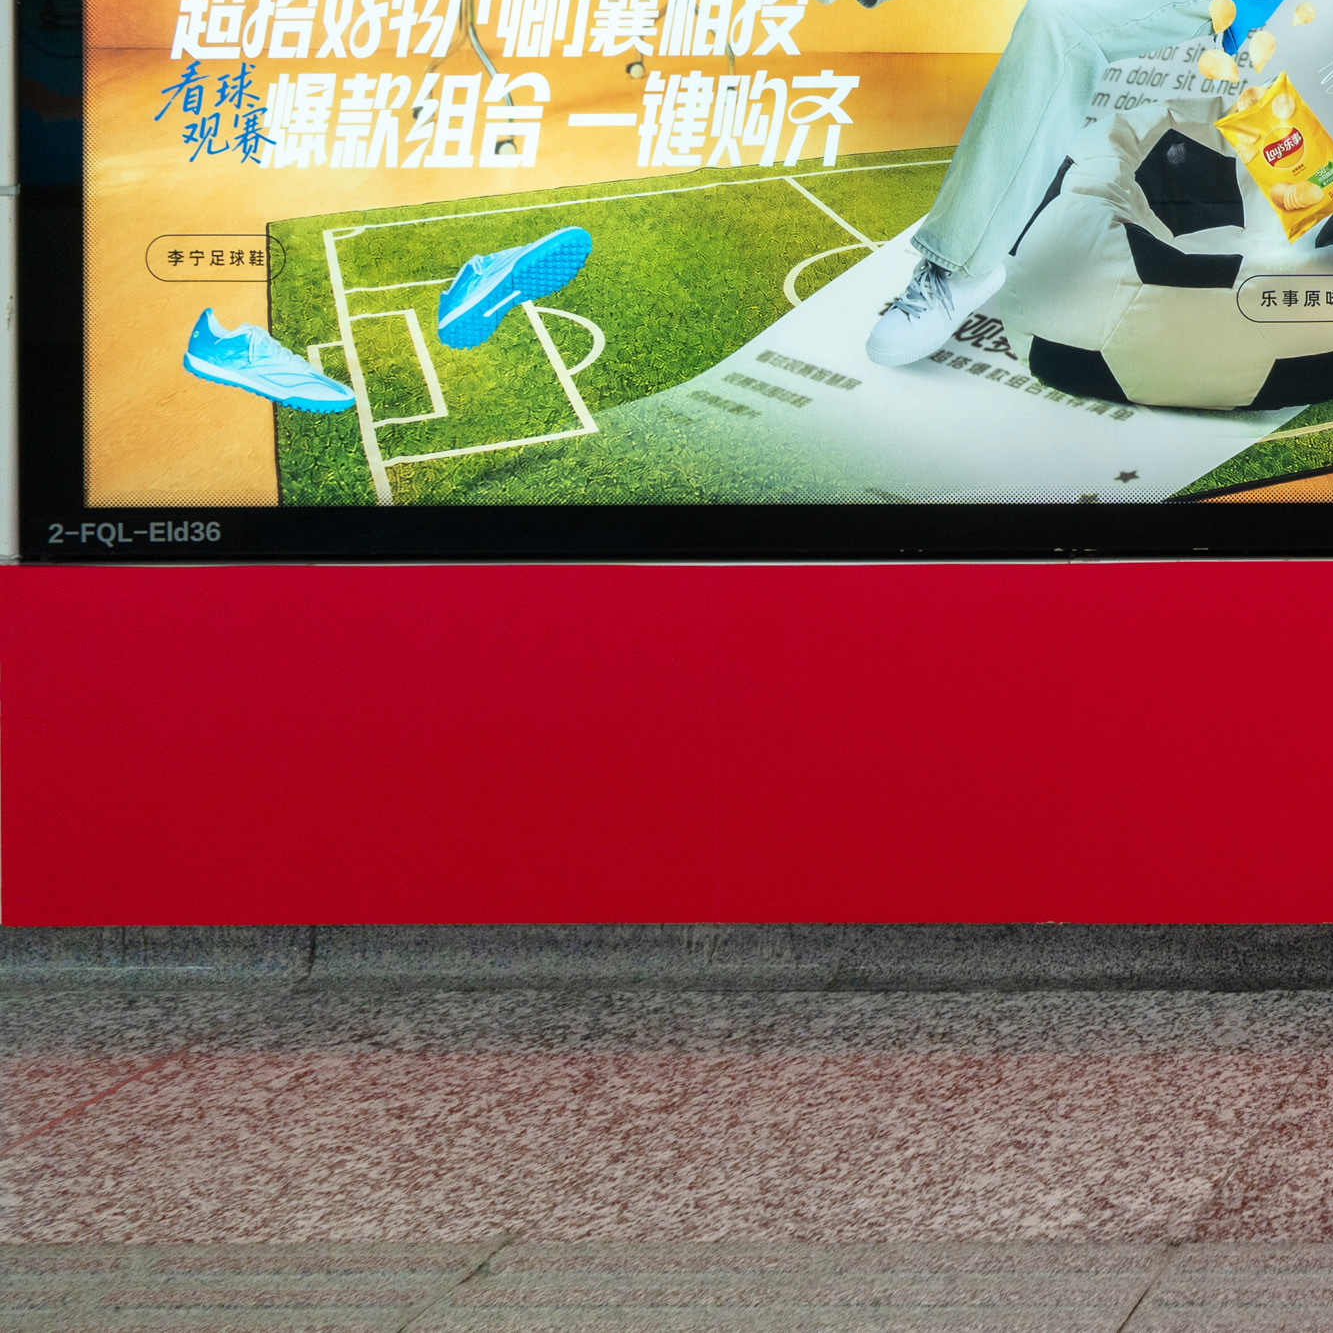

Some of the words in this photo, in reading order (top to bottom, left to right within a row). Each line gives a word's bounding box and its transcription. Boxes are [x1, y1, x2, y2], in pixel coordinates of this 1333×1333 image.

[154, 60, 260, 121] 看球
[1126, 66, 1170, 87] dolor
[1173, 71, 1197, 91] sit
[181, 103, 277, 164] 观赛
[259, 72, 550, 168] 爆款组合
[568, 70, 860, 166] 一键购齐
[168, 250, 264, 266] 李宁足球鞋
